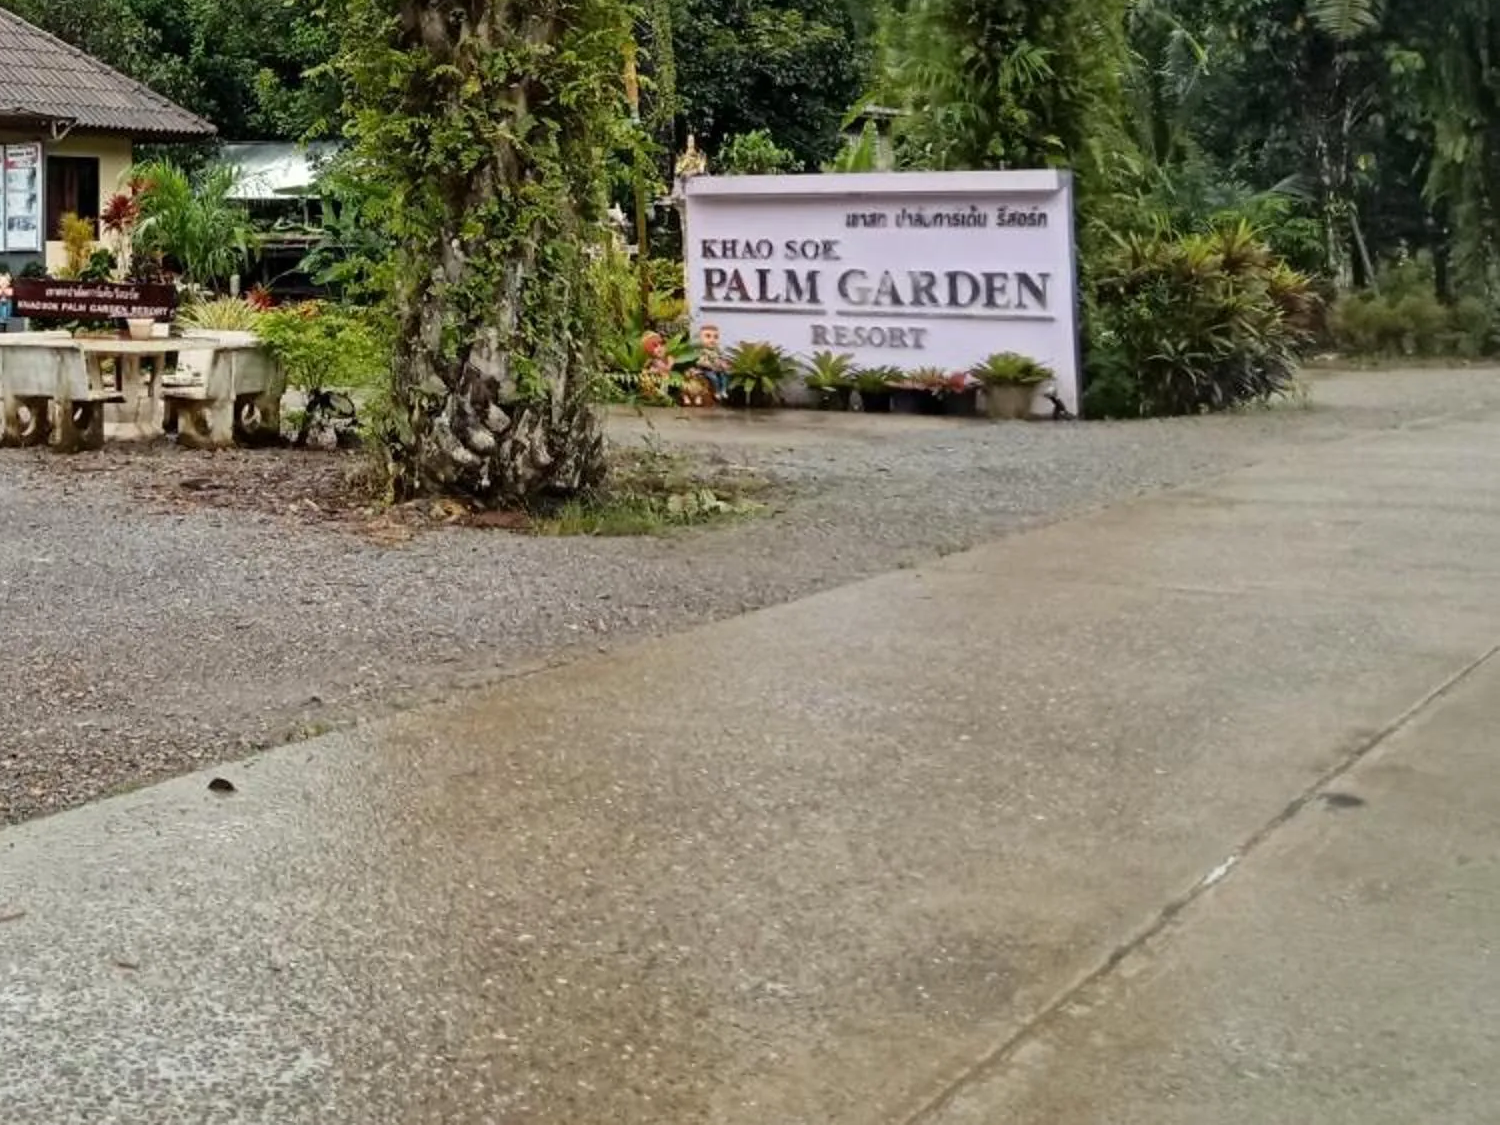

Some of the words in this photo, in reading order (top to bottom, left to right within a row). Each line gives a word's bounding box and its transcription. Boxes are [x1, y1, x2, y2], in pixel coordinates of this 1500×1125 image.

[701, 238, 774, 261] KHAO
[784, 239, 842, 262] SOK
[702, 267, 822, 305] PALM
[837, 268, 1052, 310] GARDEN
[810, 323, 929, 350] RESORT
